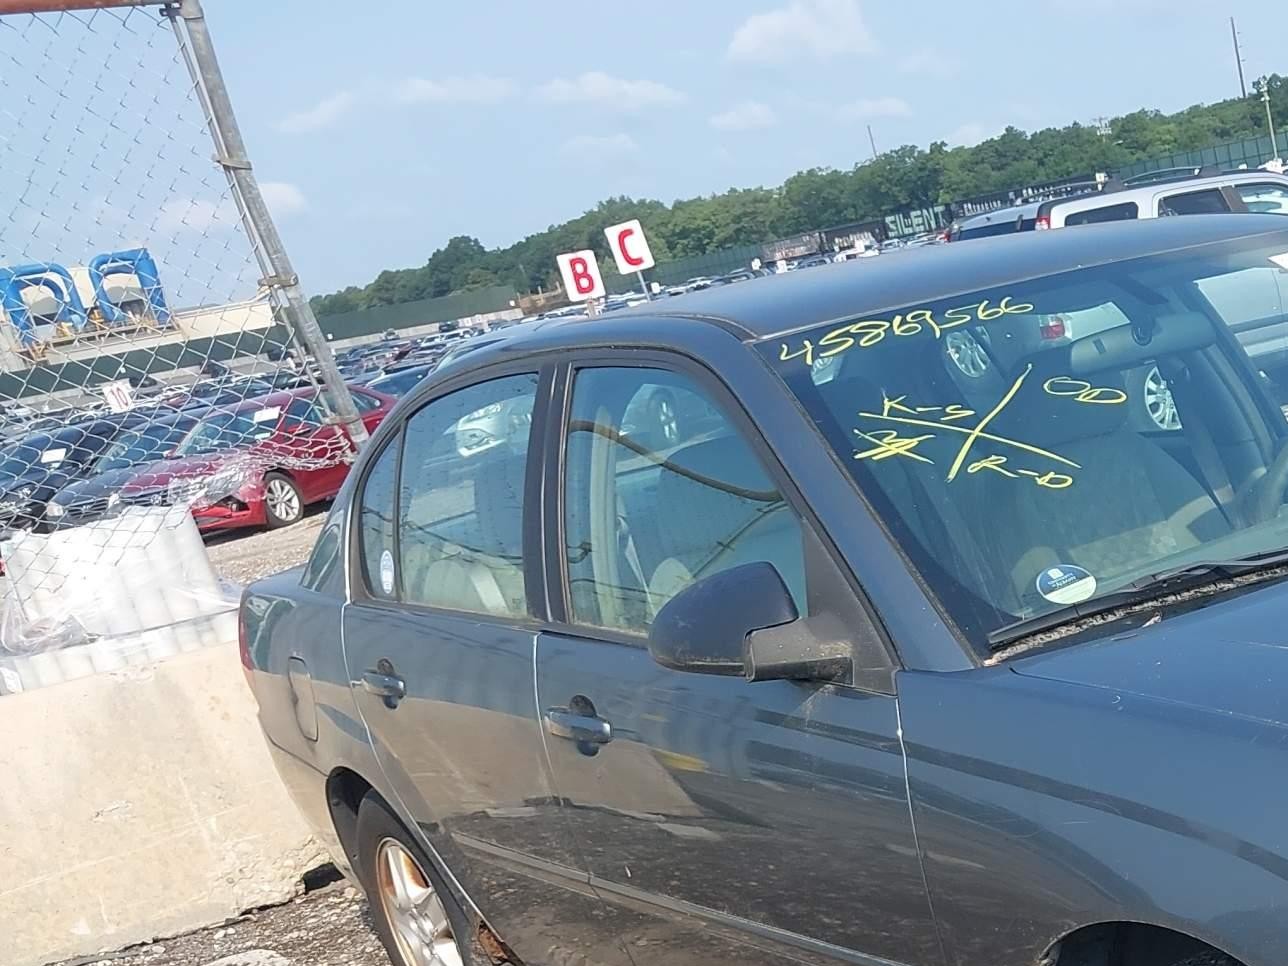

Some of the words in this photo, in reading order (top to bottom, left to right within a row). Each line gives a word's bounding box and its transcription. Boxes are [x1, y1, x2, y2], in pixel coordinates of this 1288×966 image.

[885, 205, 946, 238] SILENT
[618, 228, 644, 266] C
[568, 257, 595, 294] B
[780, 297, 1034, 365] 45869566
